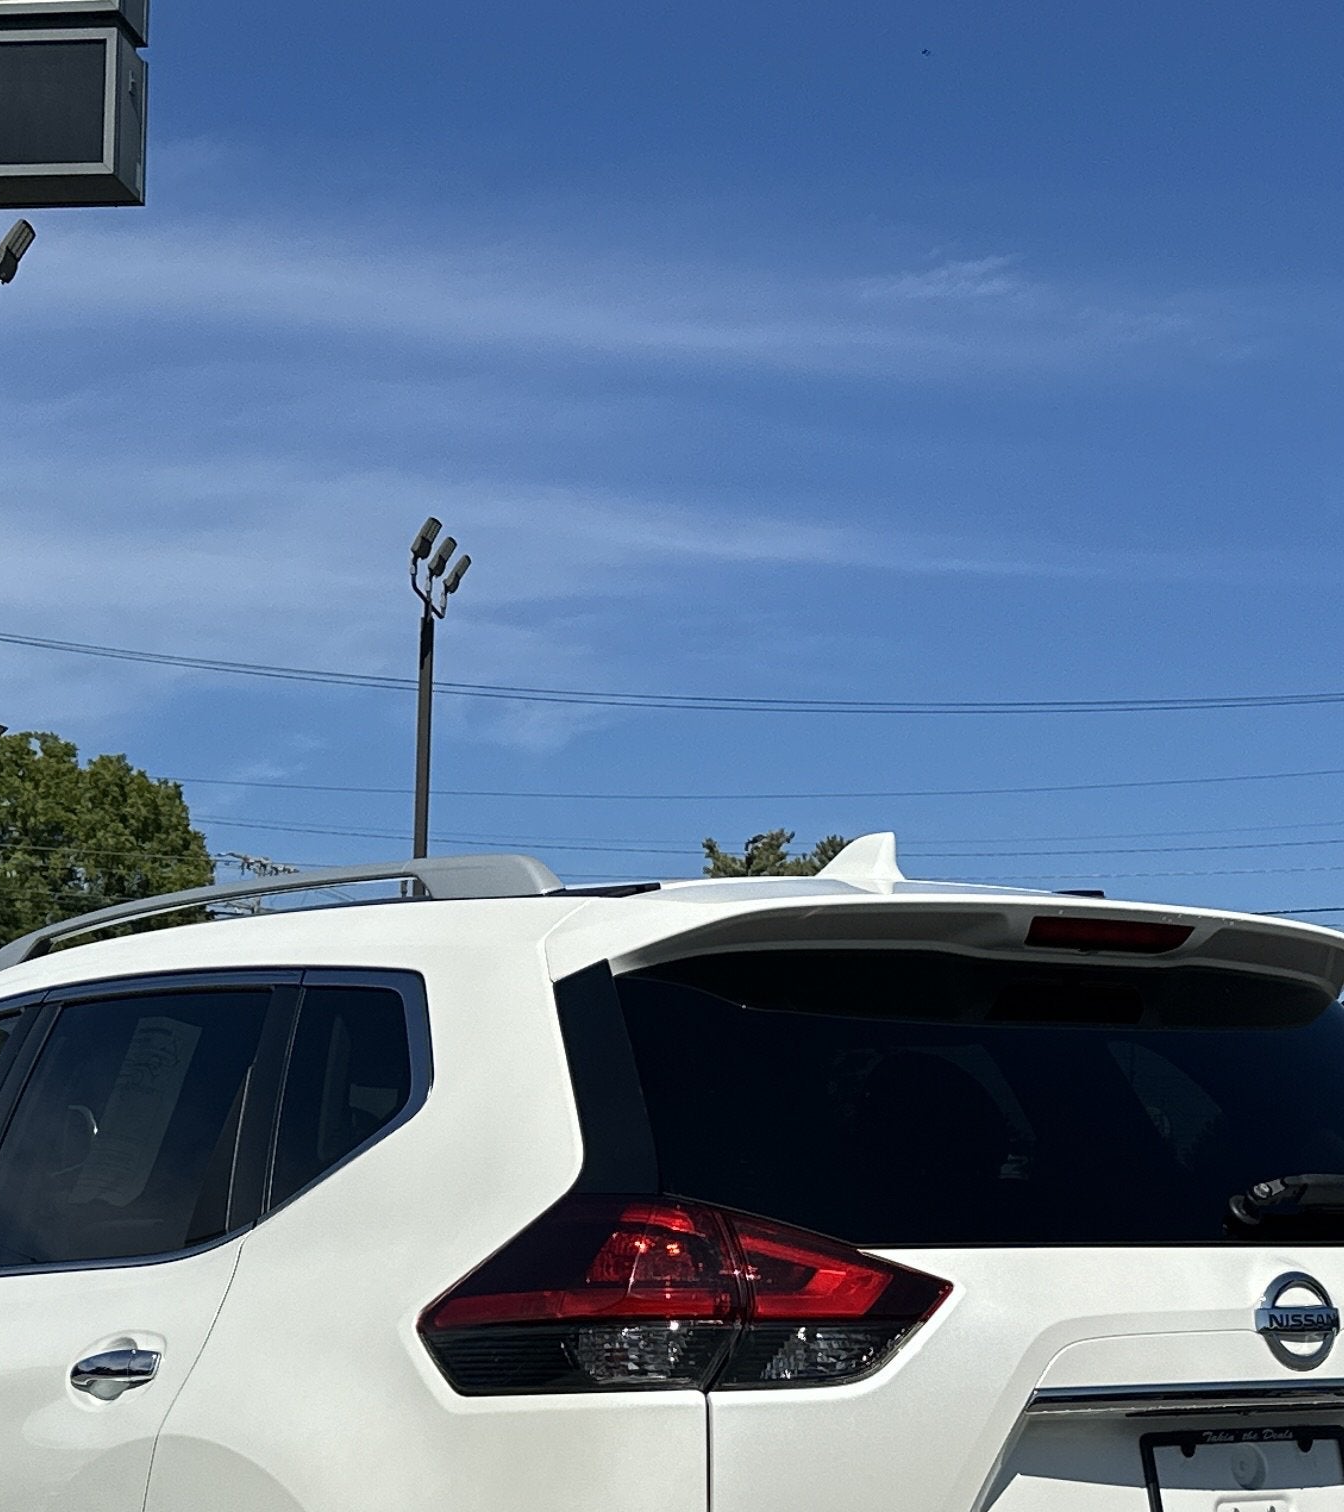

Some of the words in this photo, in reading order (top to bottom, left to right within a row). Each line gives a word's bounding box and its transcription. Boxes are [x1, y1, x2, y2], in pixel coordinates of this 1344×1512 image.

[1268, 1313, 1338, 1329] NISSAN
[1242, 1429, 1258, 1441] the
[1262, 1428, 1294, 1441] Deals
